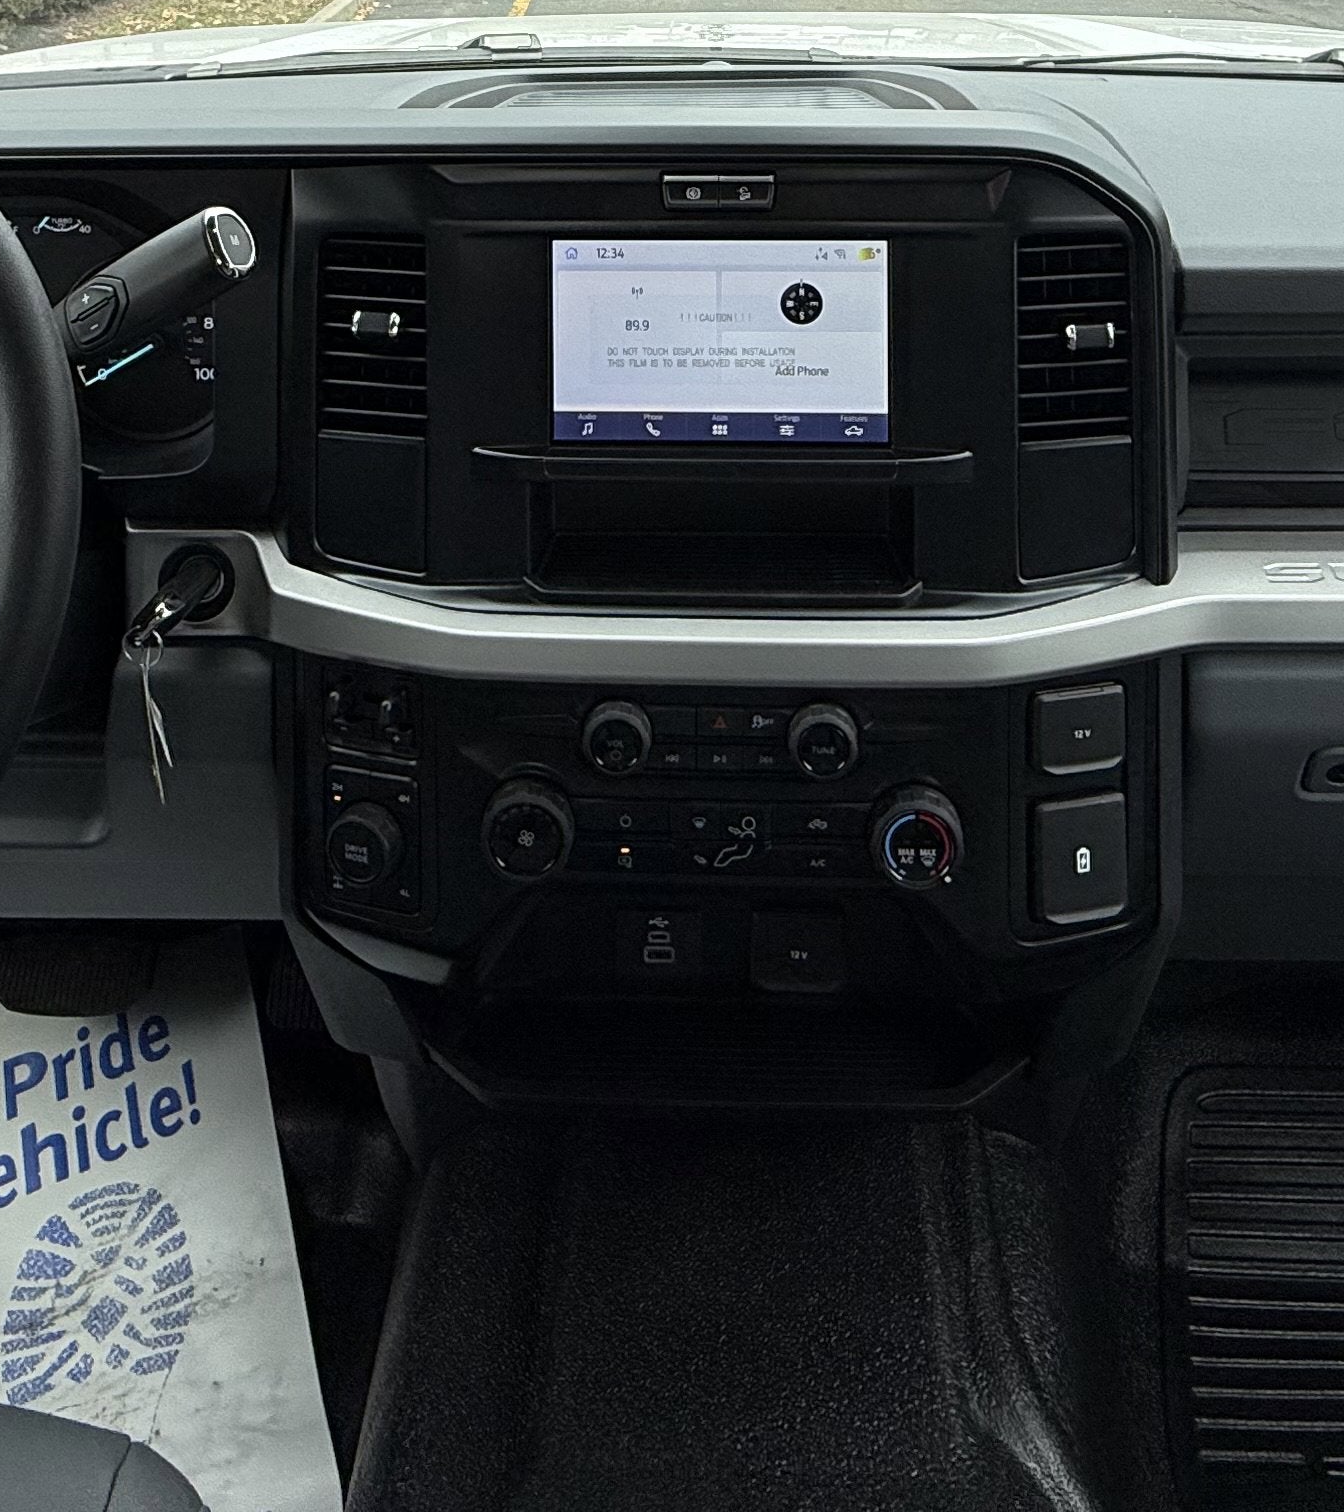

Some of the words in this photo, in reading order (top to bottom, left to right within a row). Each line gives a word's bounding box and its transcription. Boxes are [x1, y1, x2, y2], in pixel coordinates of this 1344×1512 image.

[79, 225, 92, 235] 40
[595, 248, 625, 260] 12:34
[625, 319, 650, 332] 89.9
[607, 347, 619, 357] DO
[622, 347, 639, 356] NOT
[607, 359, 626, 368] THIS
[662, 359, 674, 368] TO
[775, 366, 795, 377] Add
[797, 365, 830, 377] Phone
[2, 1011, 171, 1121] Pride
